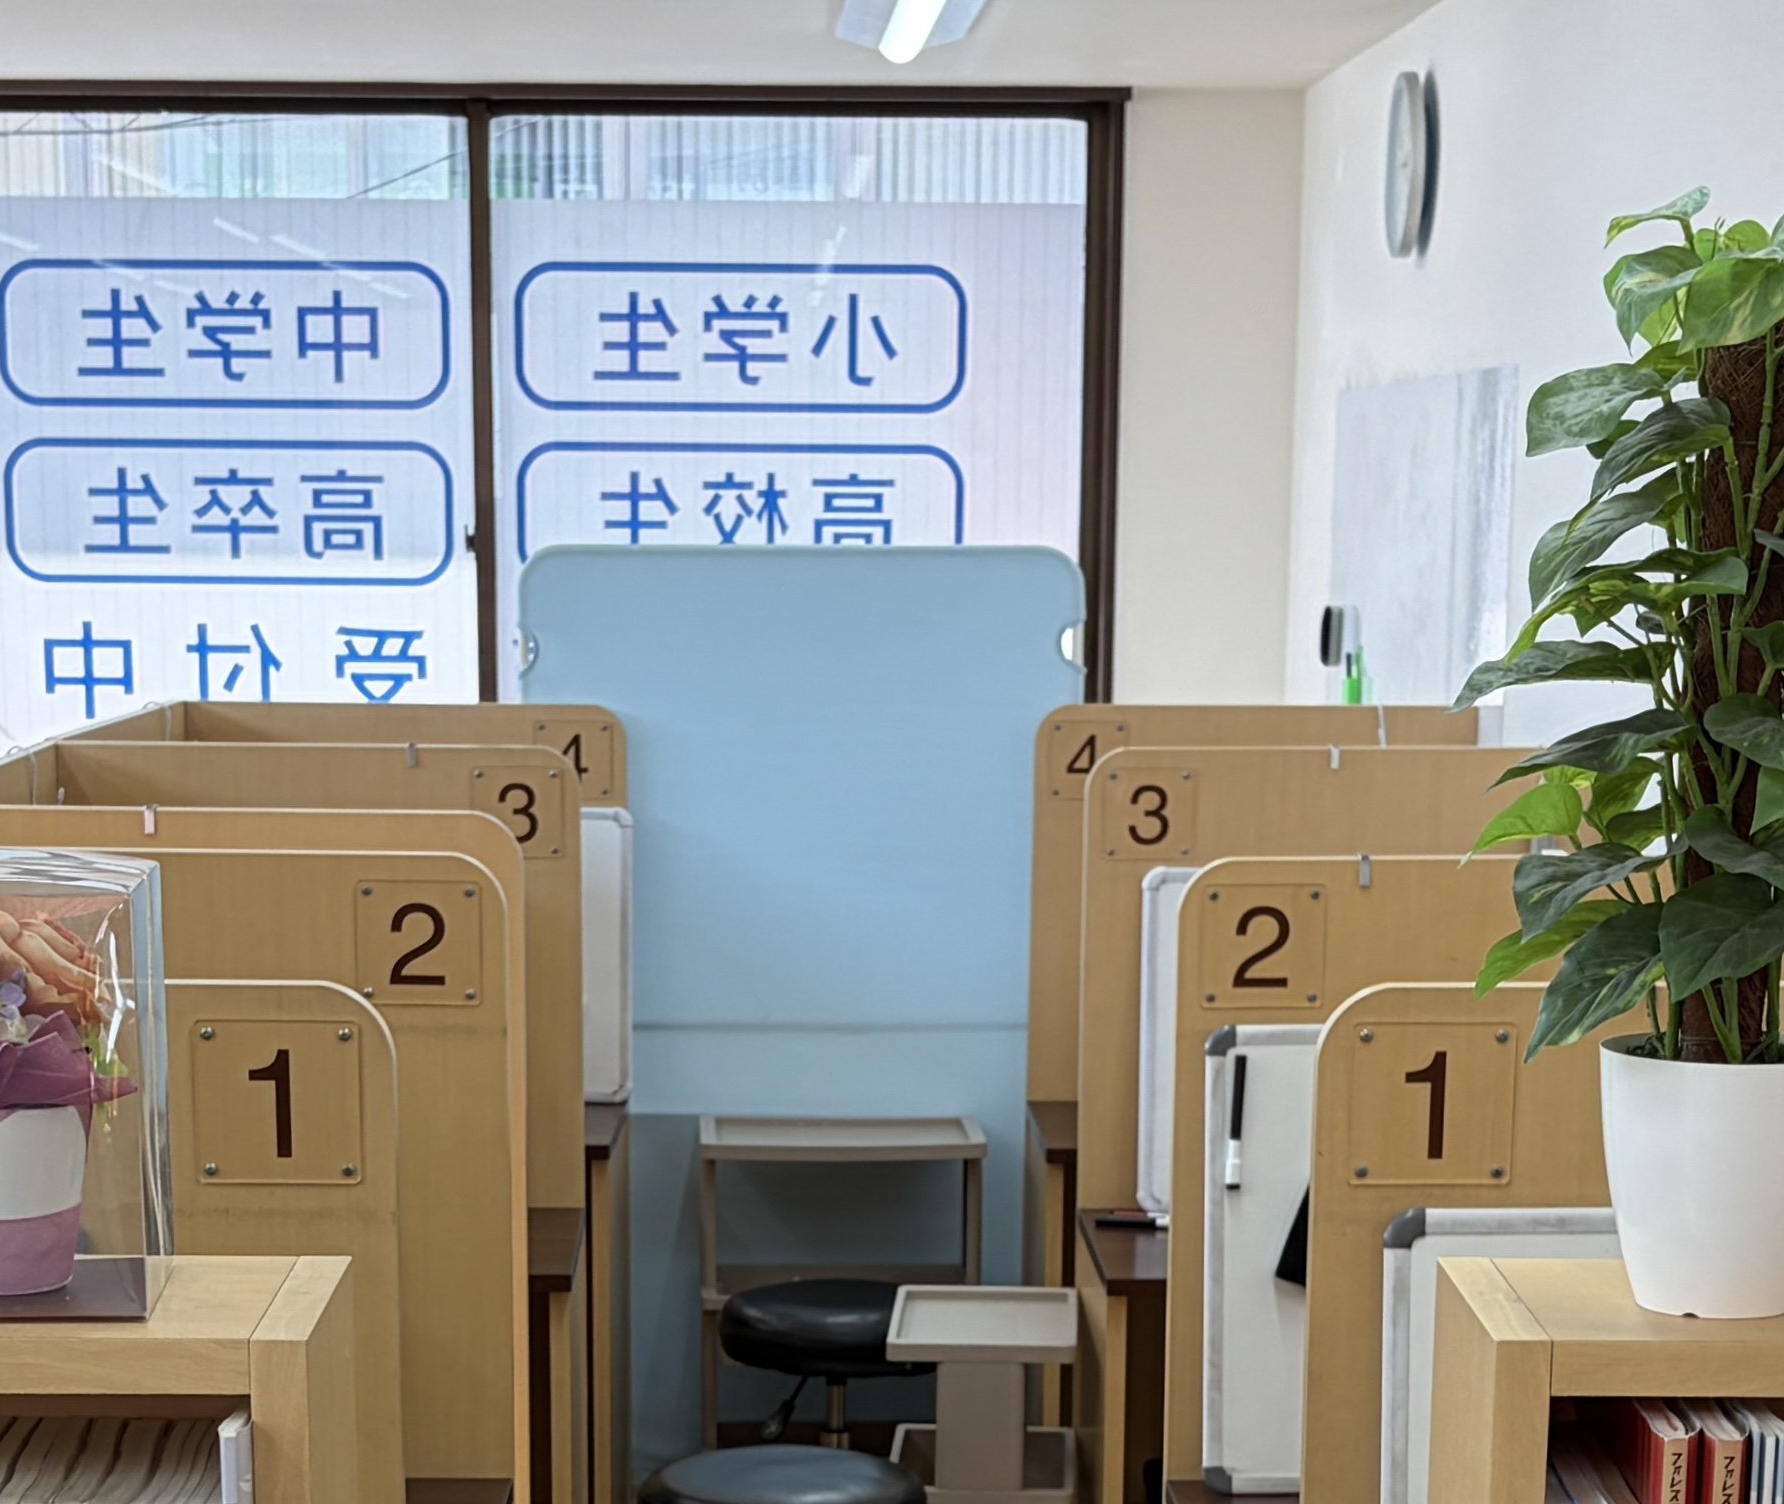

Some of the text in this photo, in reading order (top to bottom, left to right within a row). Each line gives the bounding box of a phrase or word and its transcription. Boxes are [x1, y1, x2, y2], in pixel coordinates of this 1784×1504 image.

[1066, 734, 1097, 775] 4
[497, 782, 539, 844] 3
[1128, 785, 1169, 845] 3
[389, 903, 445, 986] 2
[1232, 906, 1290, 988] 2
[248, 1048, 292, 1158] 1
[1405, 1050, 1447, 1160] 1
